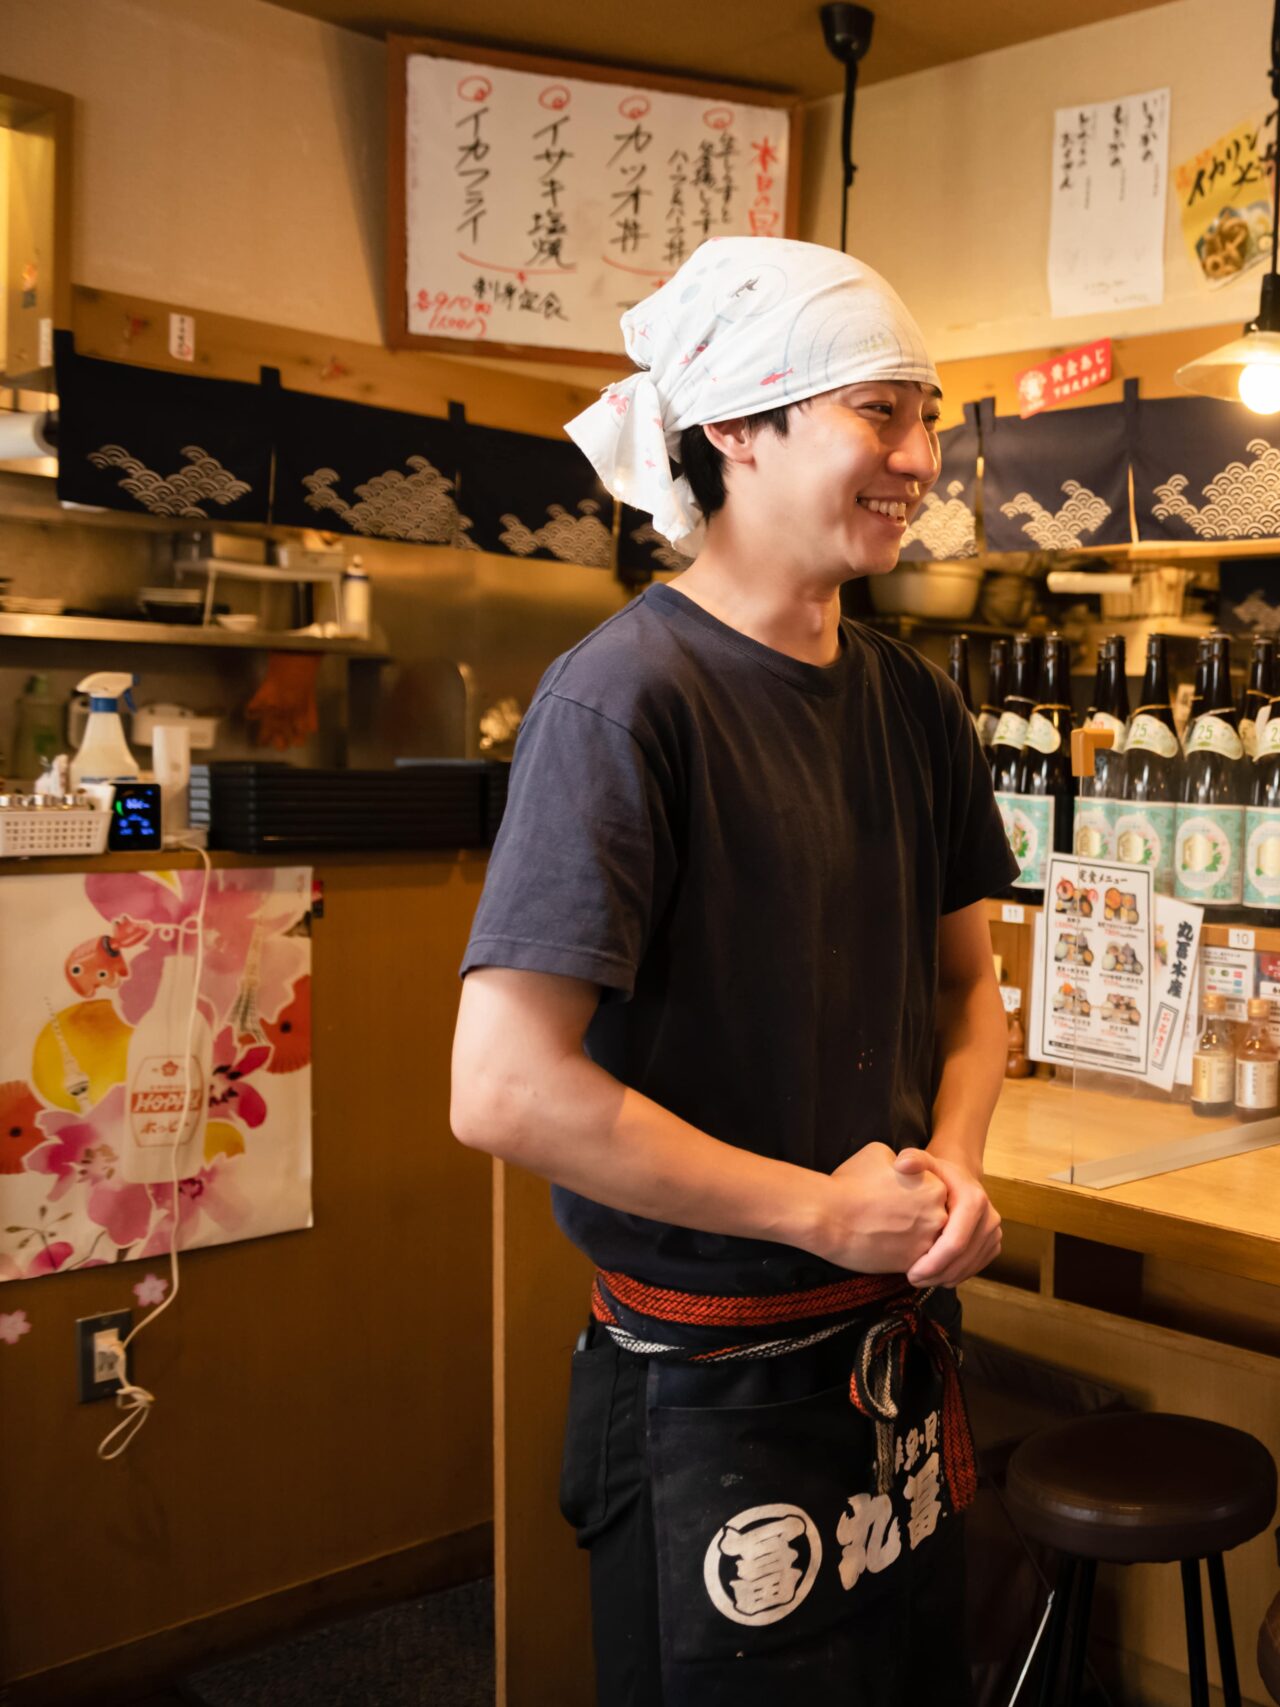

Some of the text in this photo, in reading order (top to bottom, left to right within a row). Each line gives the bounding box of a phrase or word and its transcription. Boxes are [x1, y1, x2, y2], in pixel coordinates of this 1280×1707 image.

[455, 106, 491, 244] イカフライ
[1198, 724, 1215, 740] 25
[1236, 933, 1250, 945] 10
